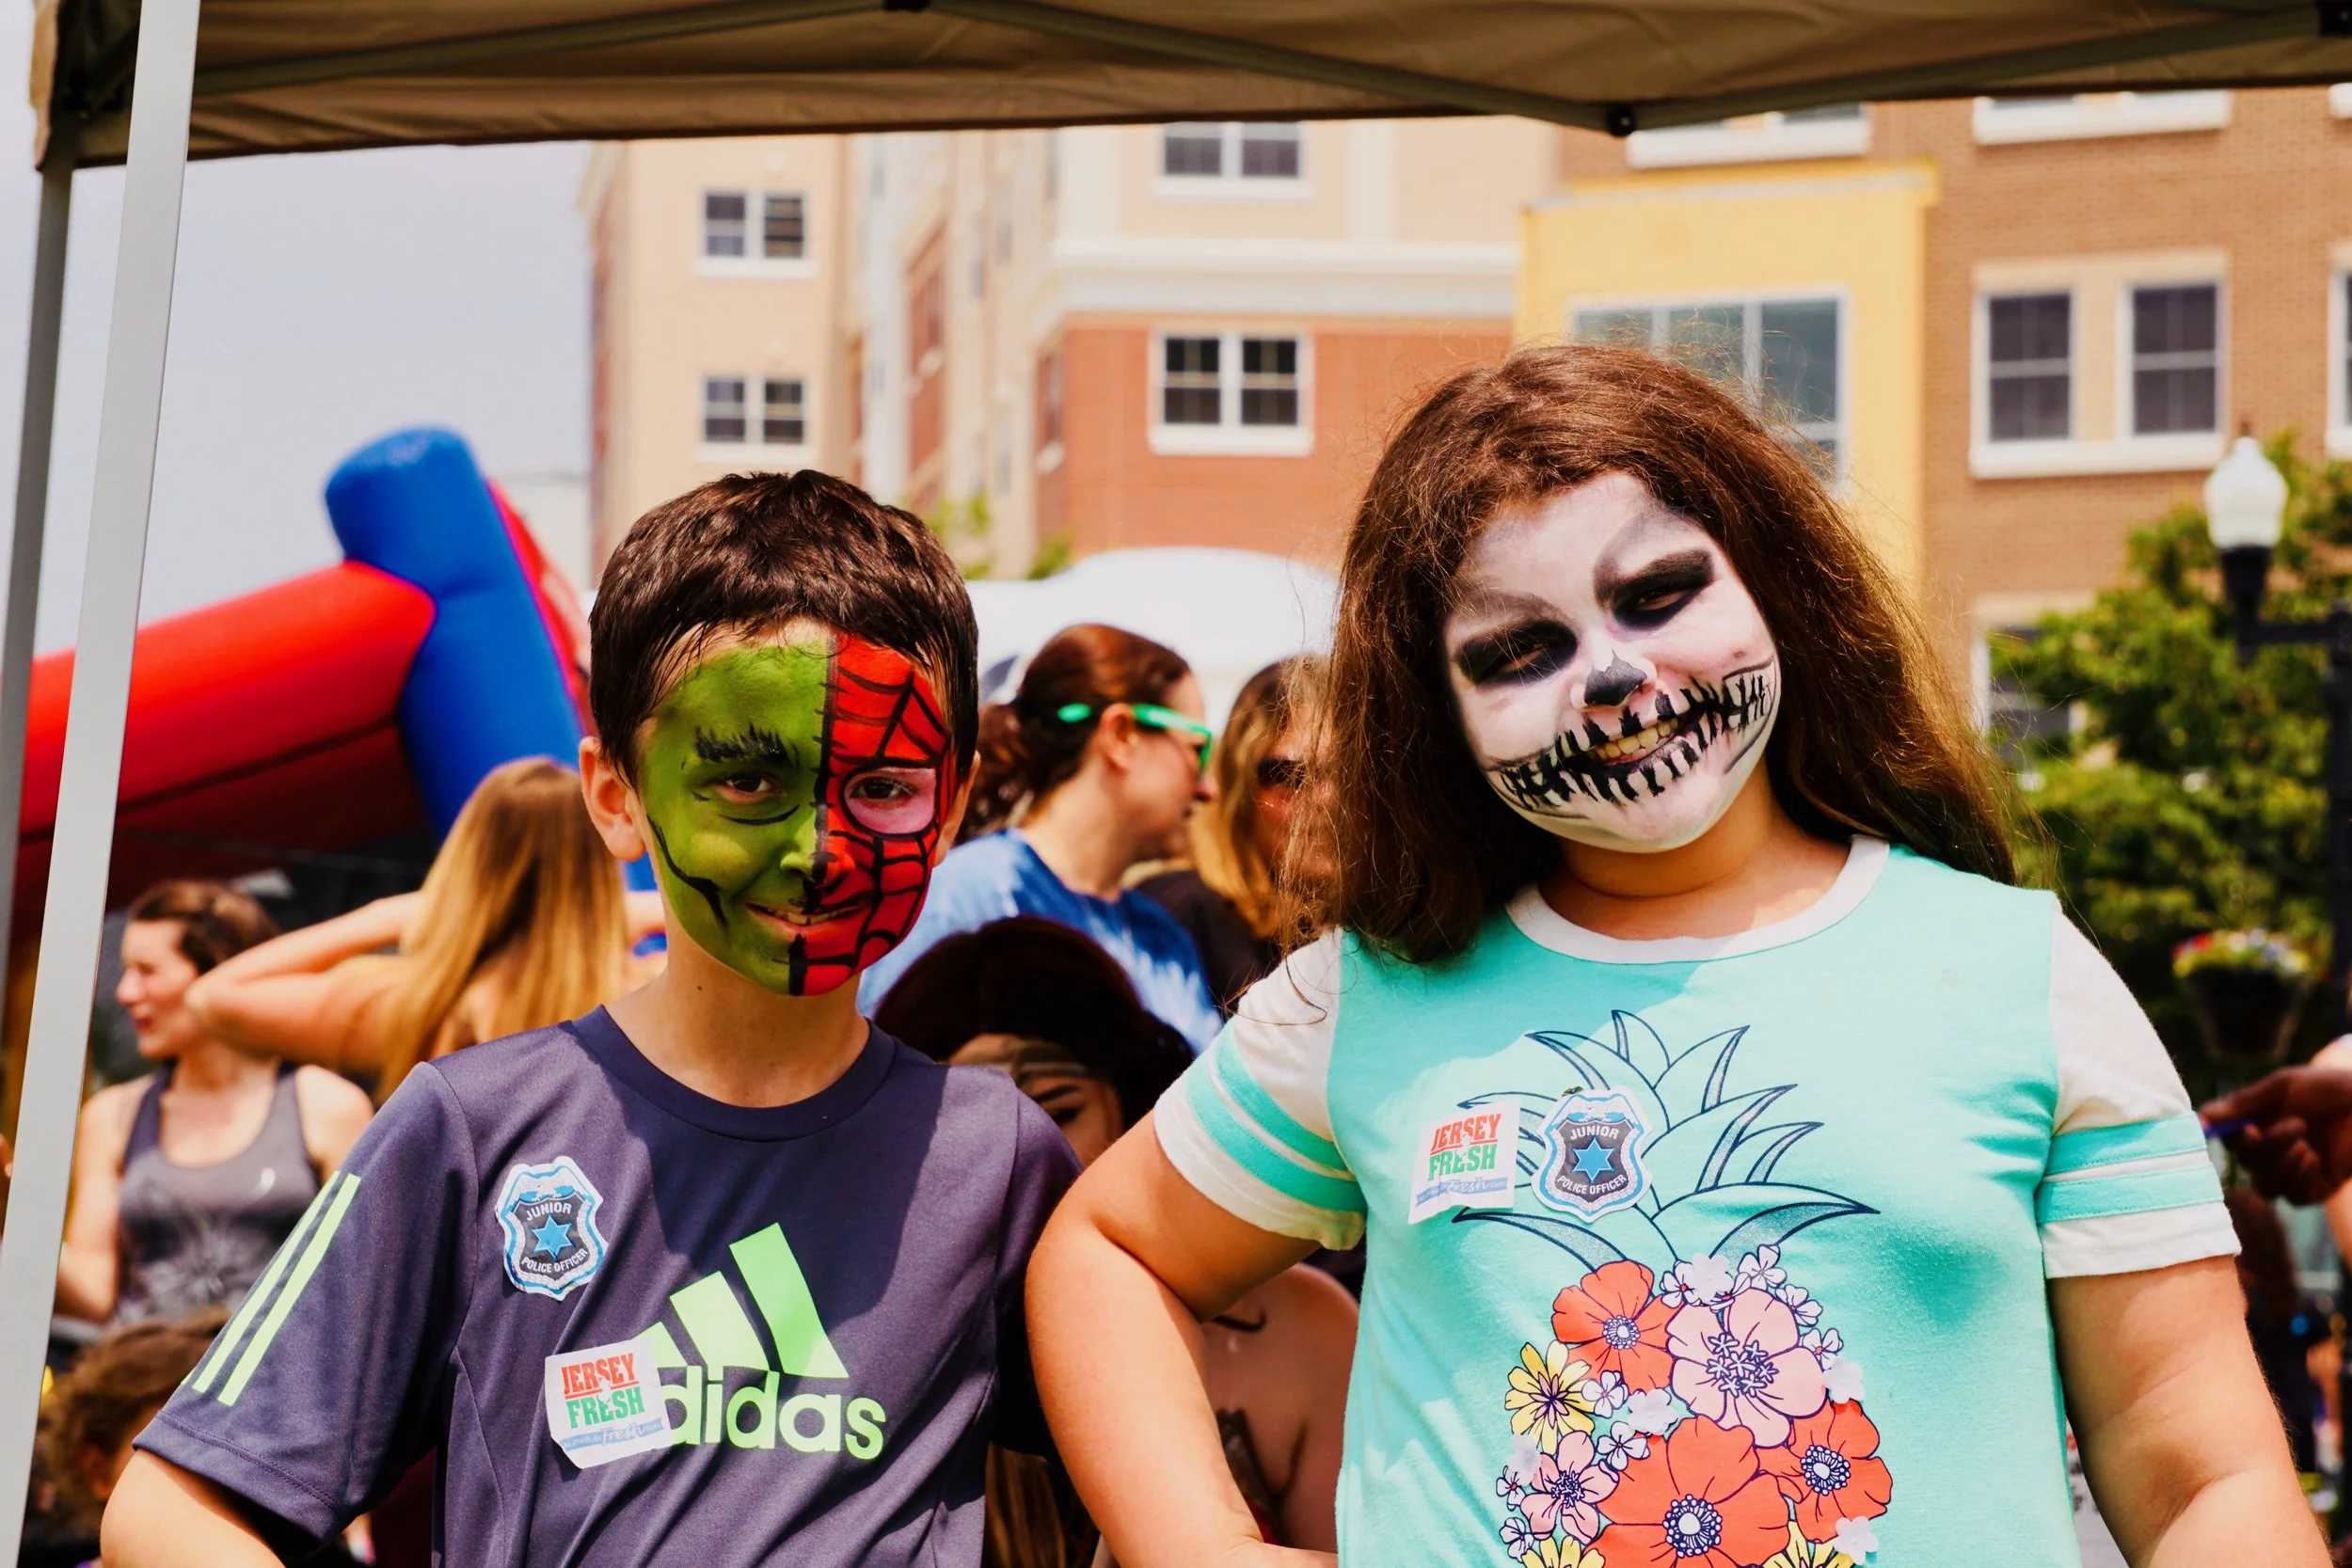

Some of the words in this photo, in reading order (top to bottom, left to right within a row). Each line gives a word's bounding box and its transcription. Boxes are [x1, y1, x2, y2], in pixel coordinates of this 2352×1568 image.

[1430, 1113, 1502, 1151] JERSEY
[1570, 1125, 1619, 1140] JUNIOR
[1427, 1144, 1498, 1181] FRESH
[1557, 1175, 1587, 1195] POLICE
[1589, 1174, 1628, 1195] OFFICER
[526, 1201, 573, 1222] JUNIOR
[521, 1256, 552, 1274] POLICE
[553, 1248, 589, 1273] OFFICER
[561, 1353, 636, 1395] JERSEY
[566, 1386, 645, 1429] FRESH
[661, 1365, 886, 1460] didas
